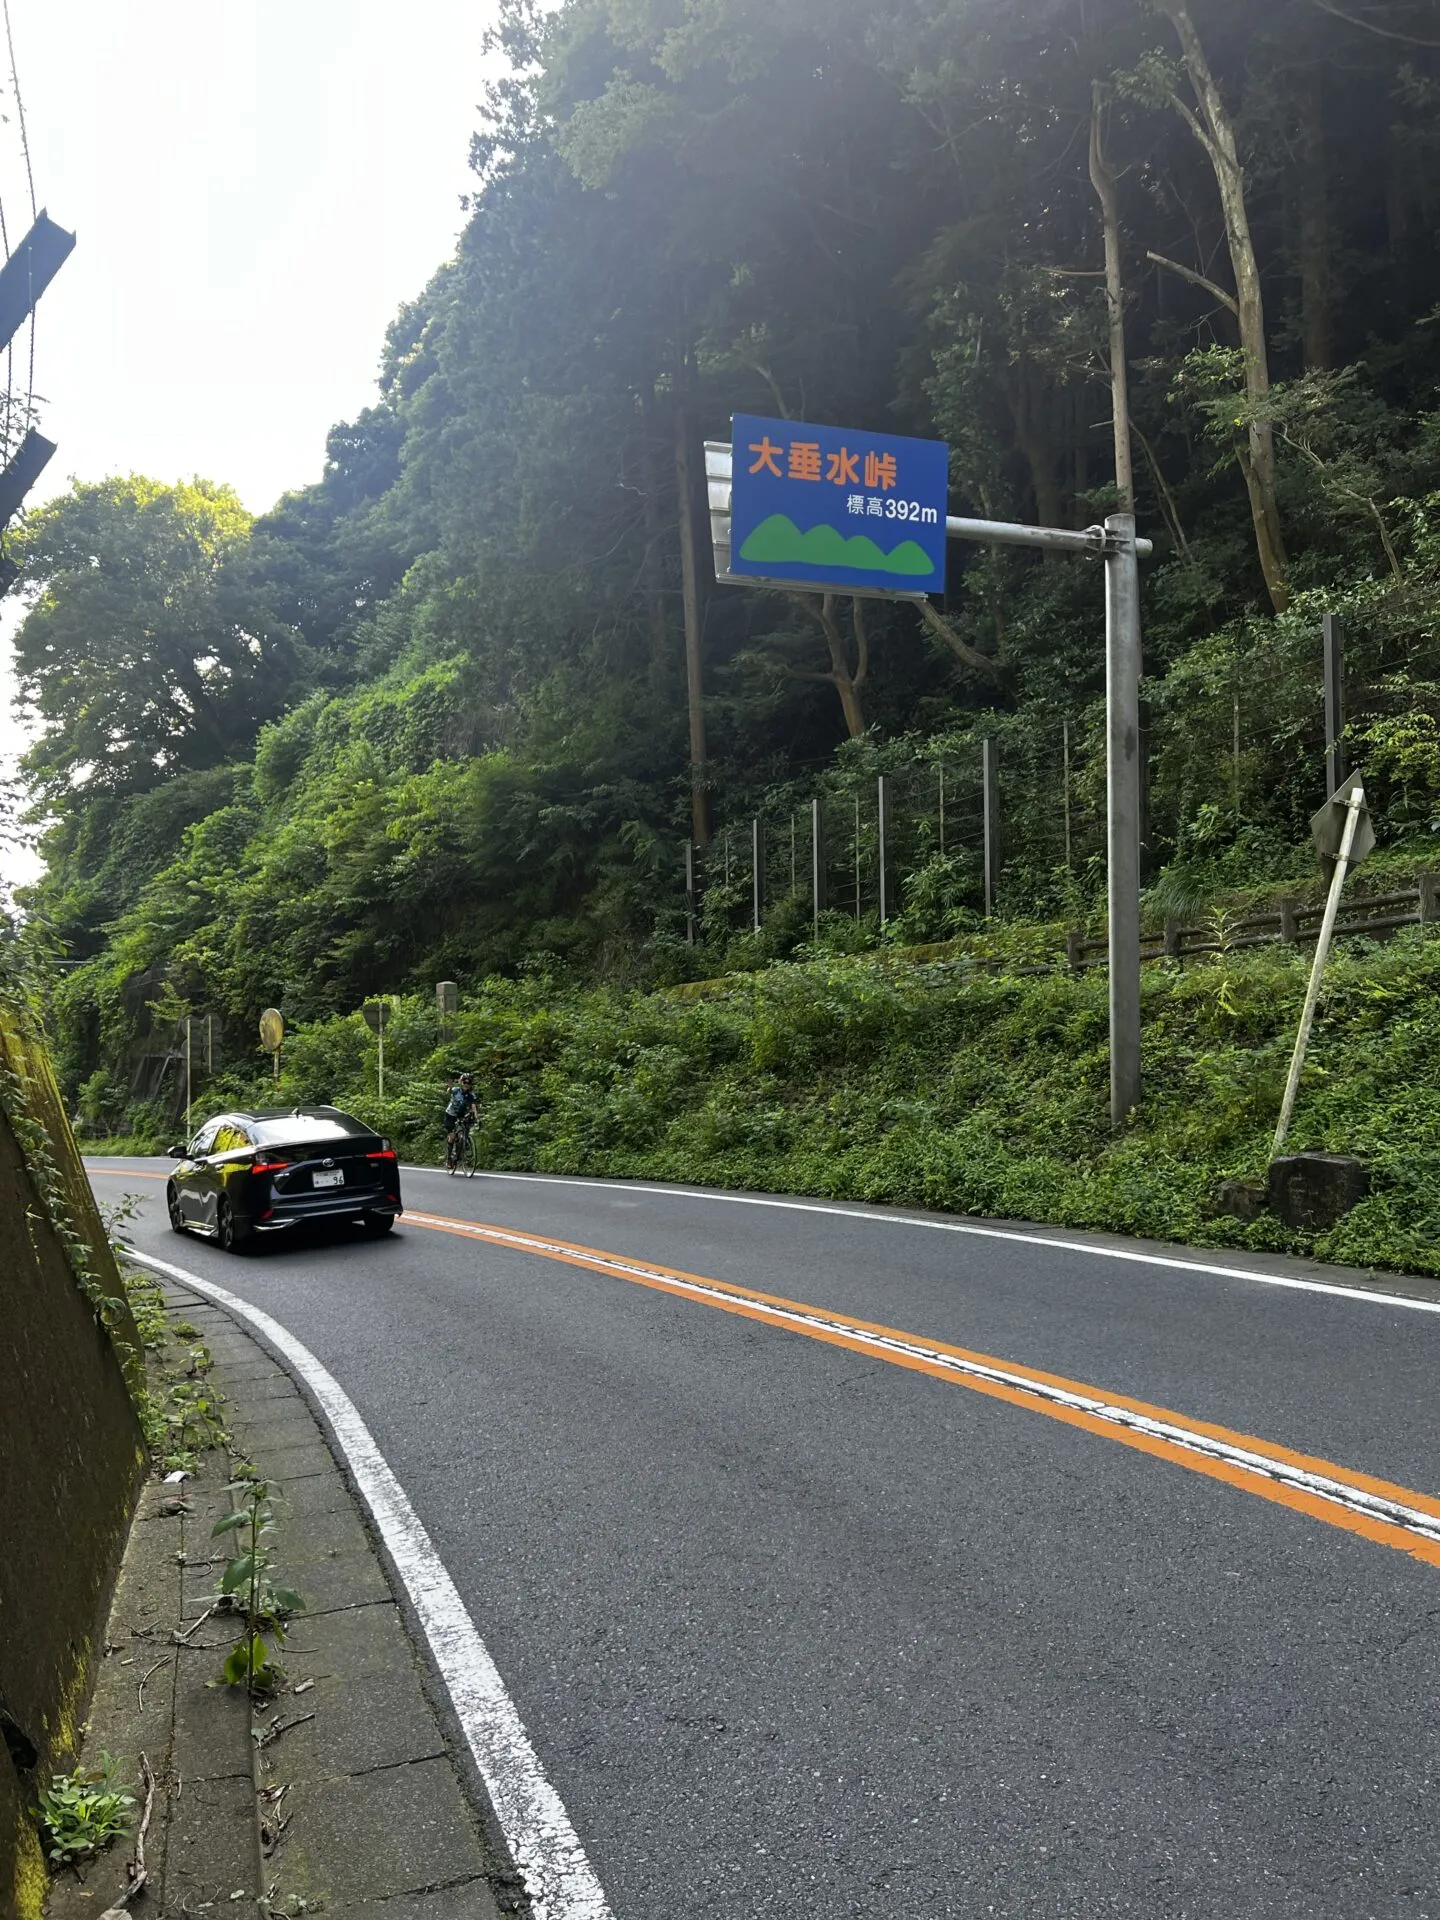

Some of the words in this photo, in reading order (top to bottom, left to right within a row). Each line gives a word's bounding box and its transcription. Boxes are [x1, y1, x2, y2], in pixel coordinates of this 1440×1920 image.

[748, 436, 897, 491] 大垂水峠
[846, 494, 938, 524] 標高392m
